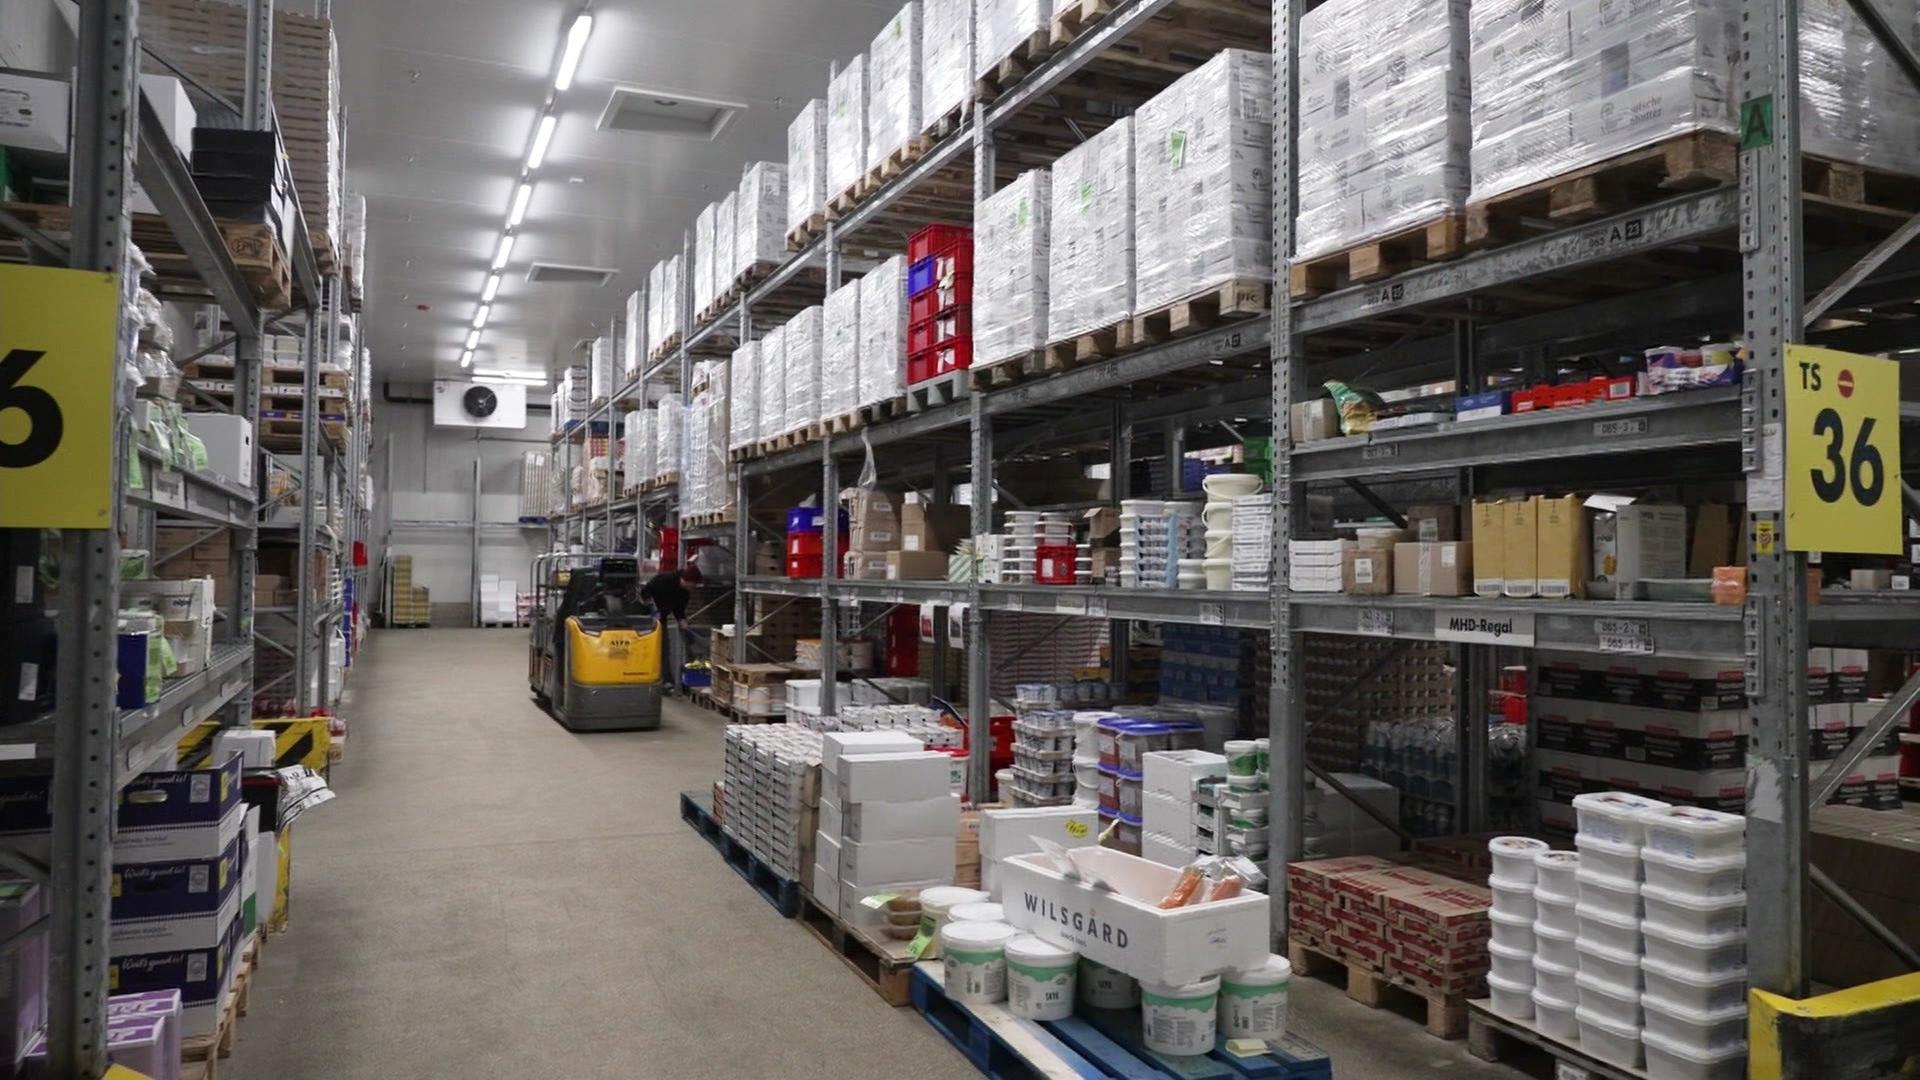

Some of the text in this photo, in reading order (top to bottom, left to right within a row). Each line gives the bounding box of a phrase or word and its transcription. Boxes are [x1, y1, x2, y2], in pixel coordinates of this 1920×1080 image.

[1744, 103, 1769, 145] A
[1610, 225, 1622, 242] A
[1627, 222, 1640, 237] 23
[1381, 288, 1390, 302] A
[1799, 361, 1822, 391] TS
[0, 349, 63, 469] 6
[1810, 408, 1884, 507] 36
[1450, 617, 1512, 637] MHD-Regal
